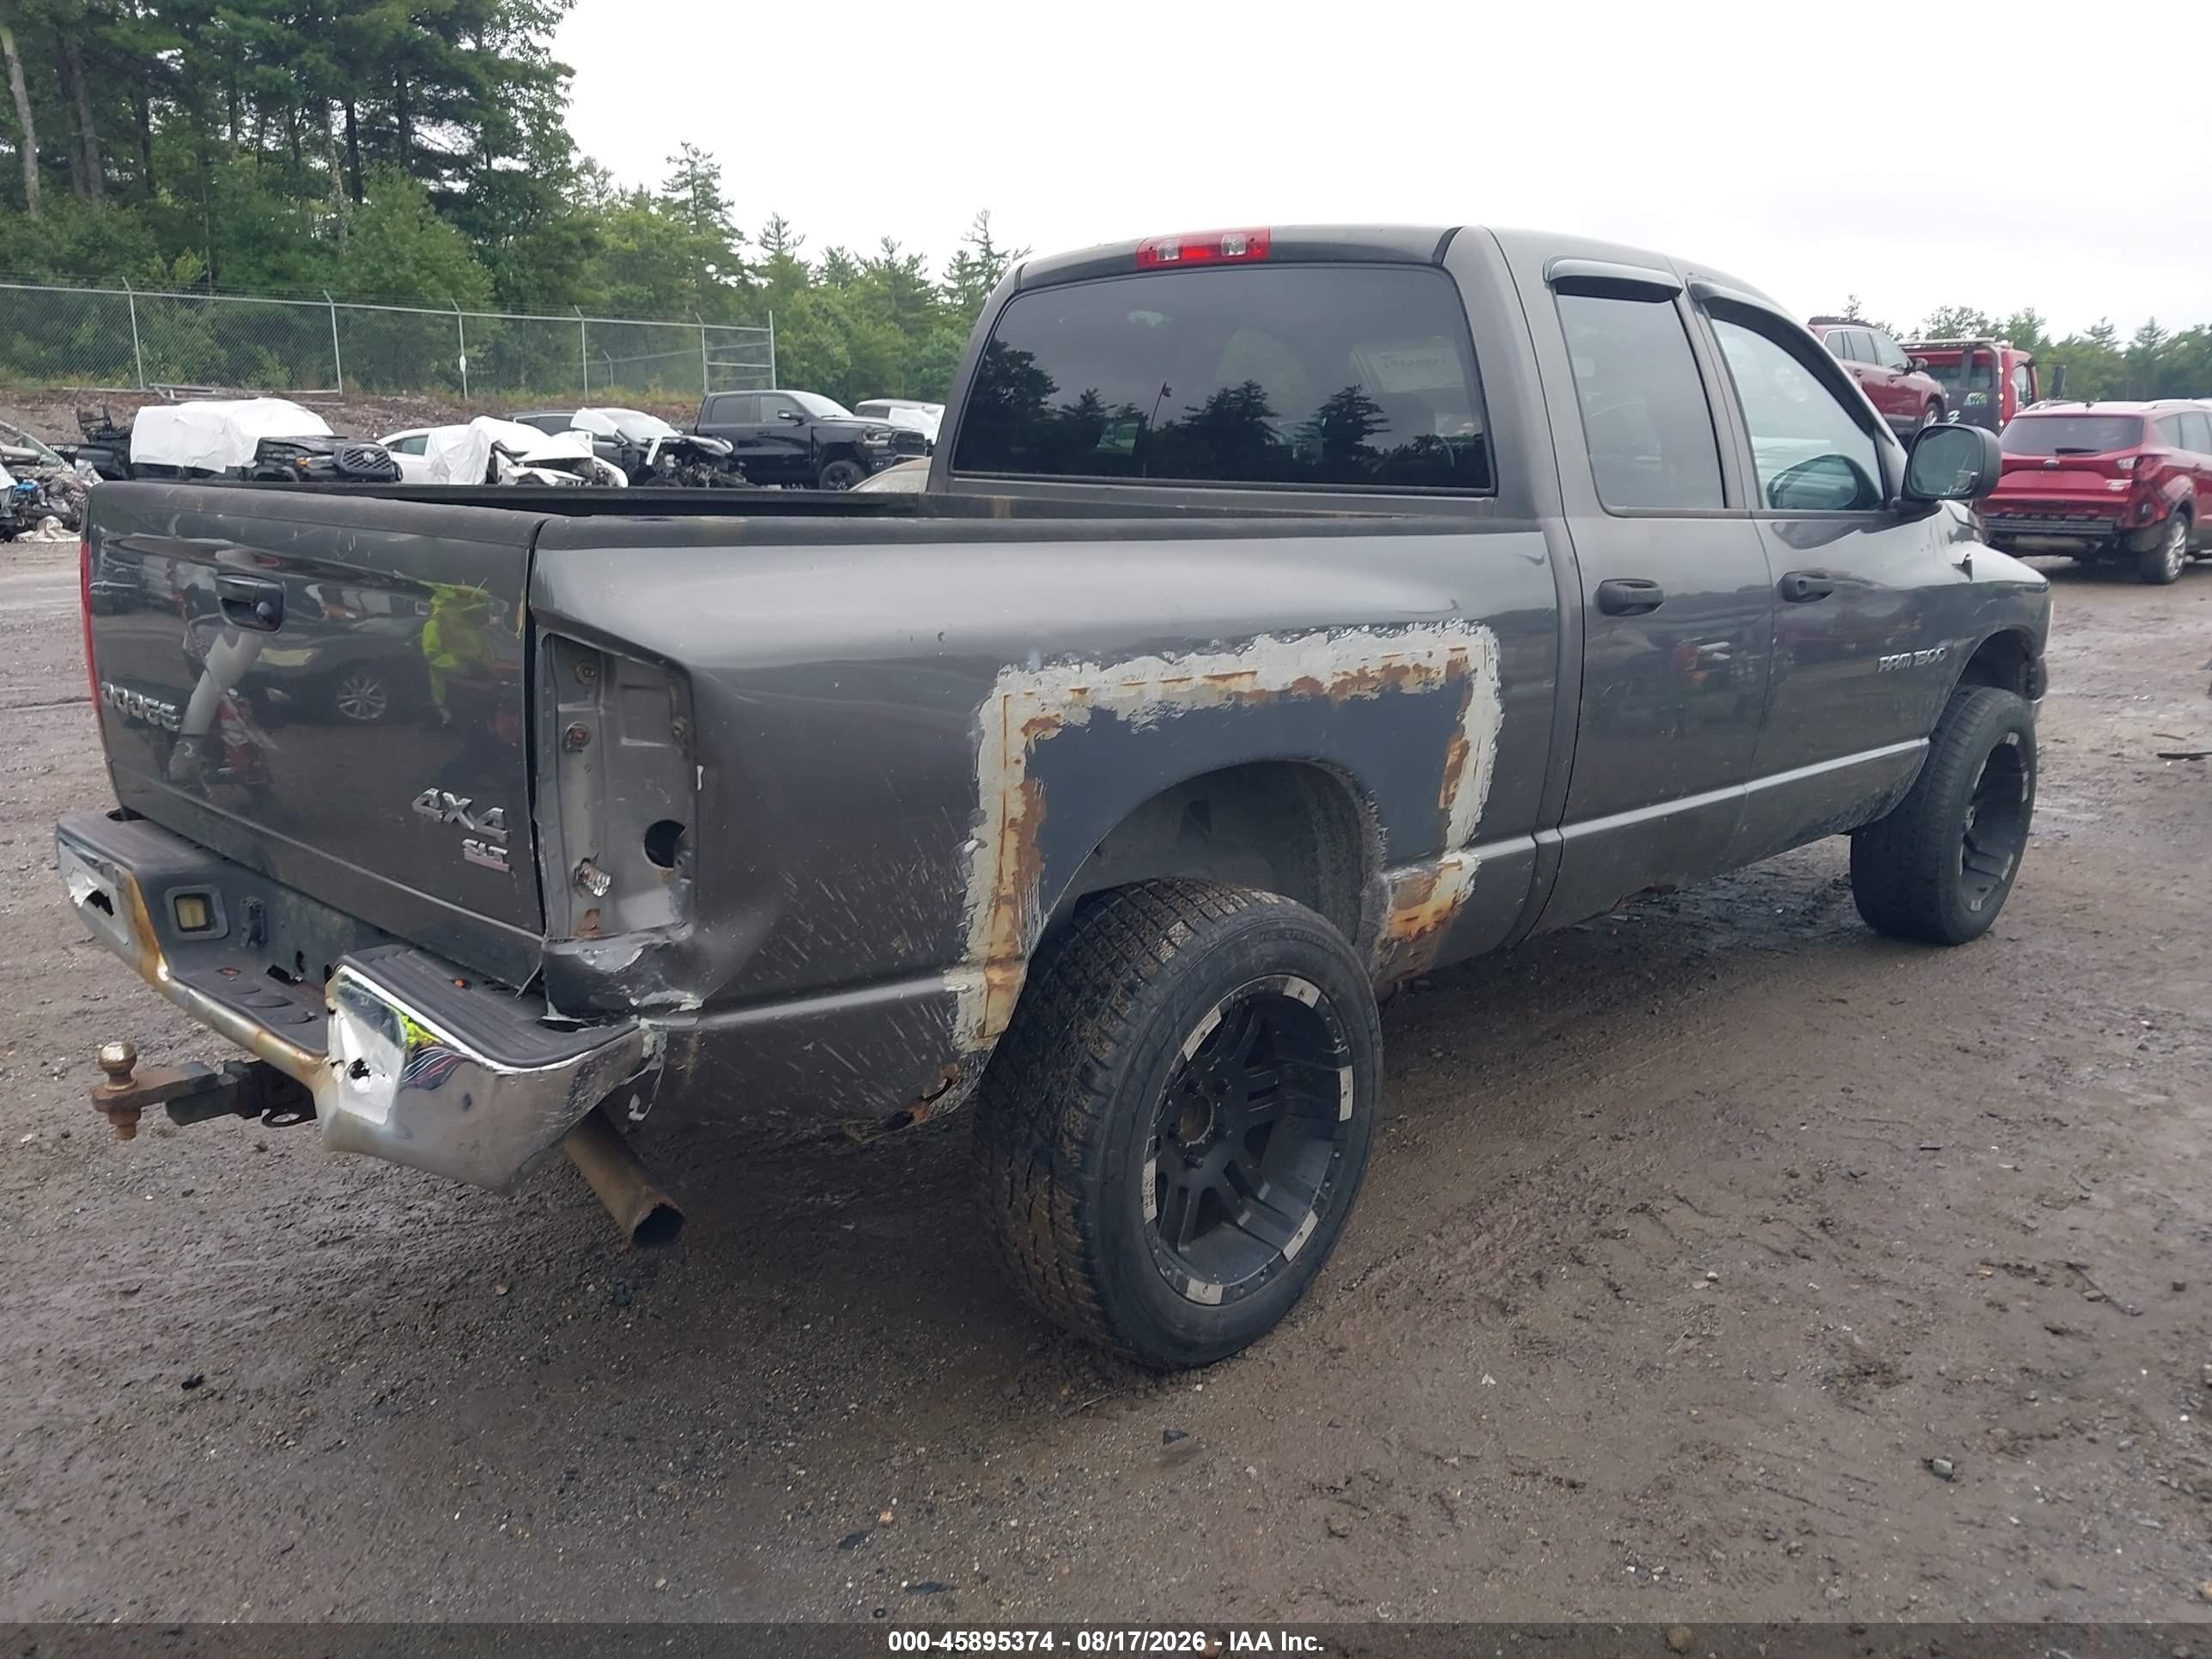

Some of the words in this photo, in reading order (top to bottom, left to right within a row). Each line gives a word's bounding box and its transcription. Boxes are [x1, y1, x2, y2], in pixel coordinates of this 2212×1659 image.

[1877, 653, 1911, 672] RAM
[1913, 647, 1948, 666] 1500
[100, 681, 180, 732] DODGE
[462, 838, 509, 871] SLT
